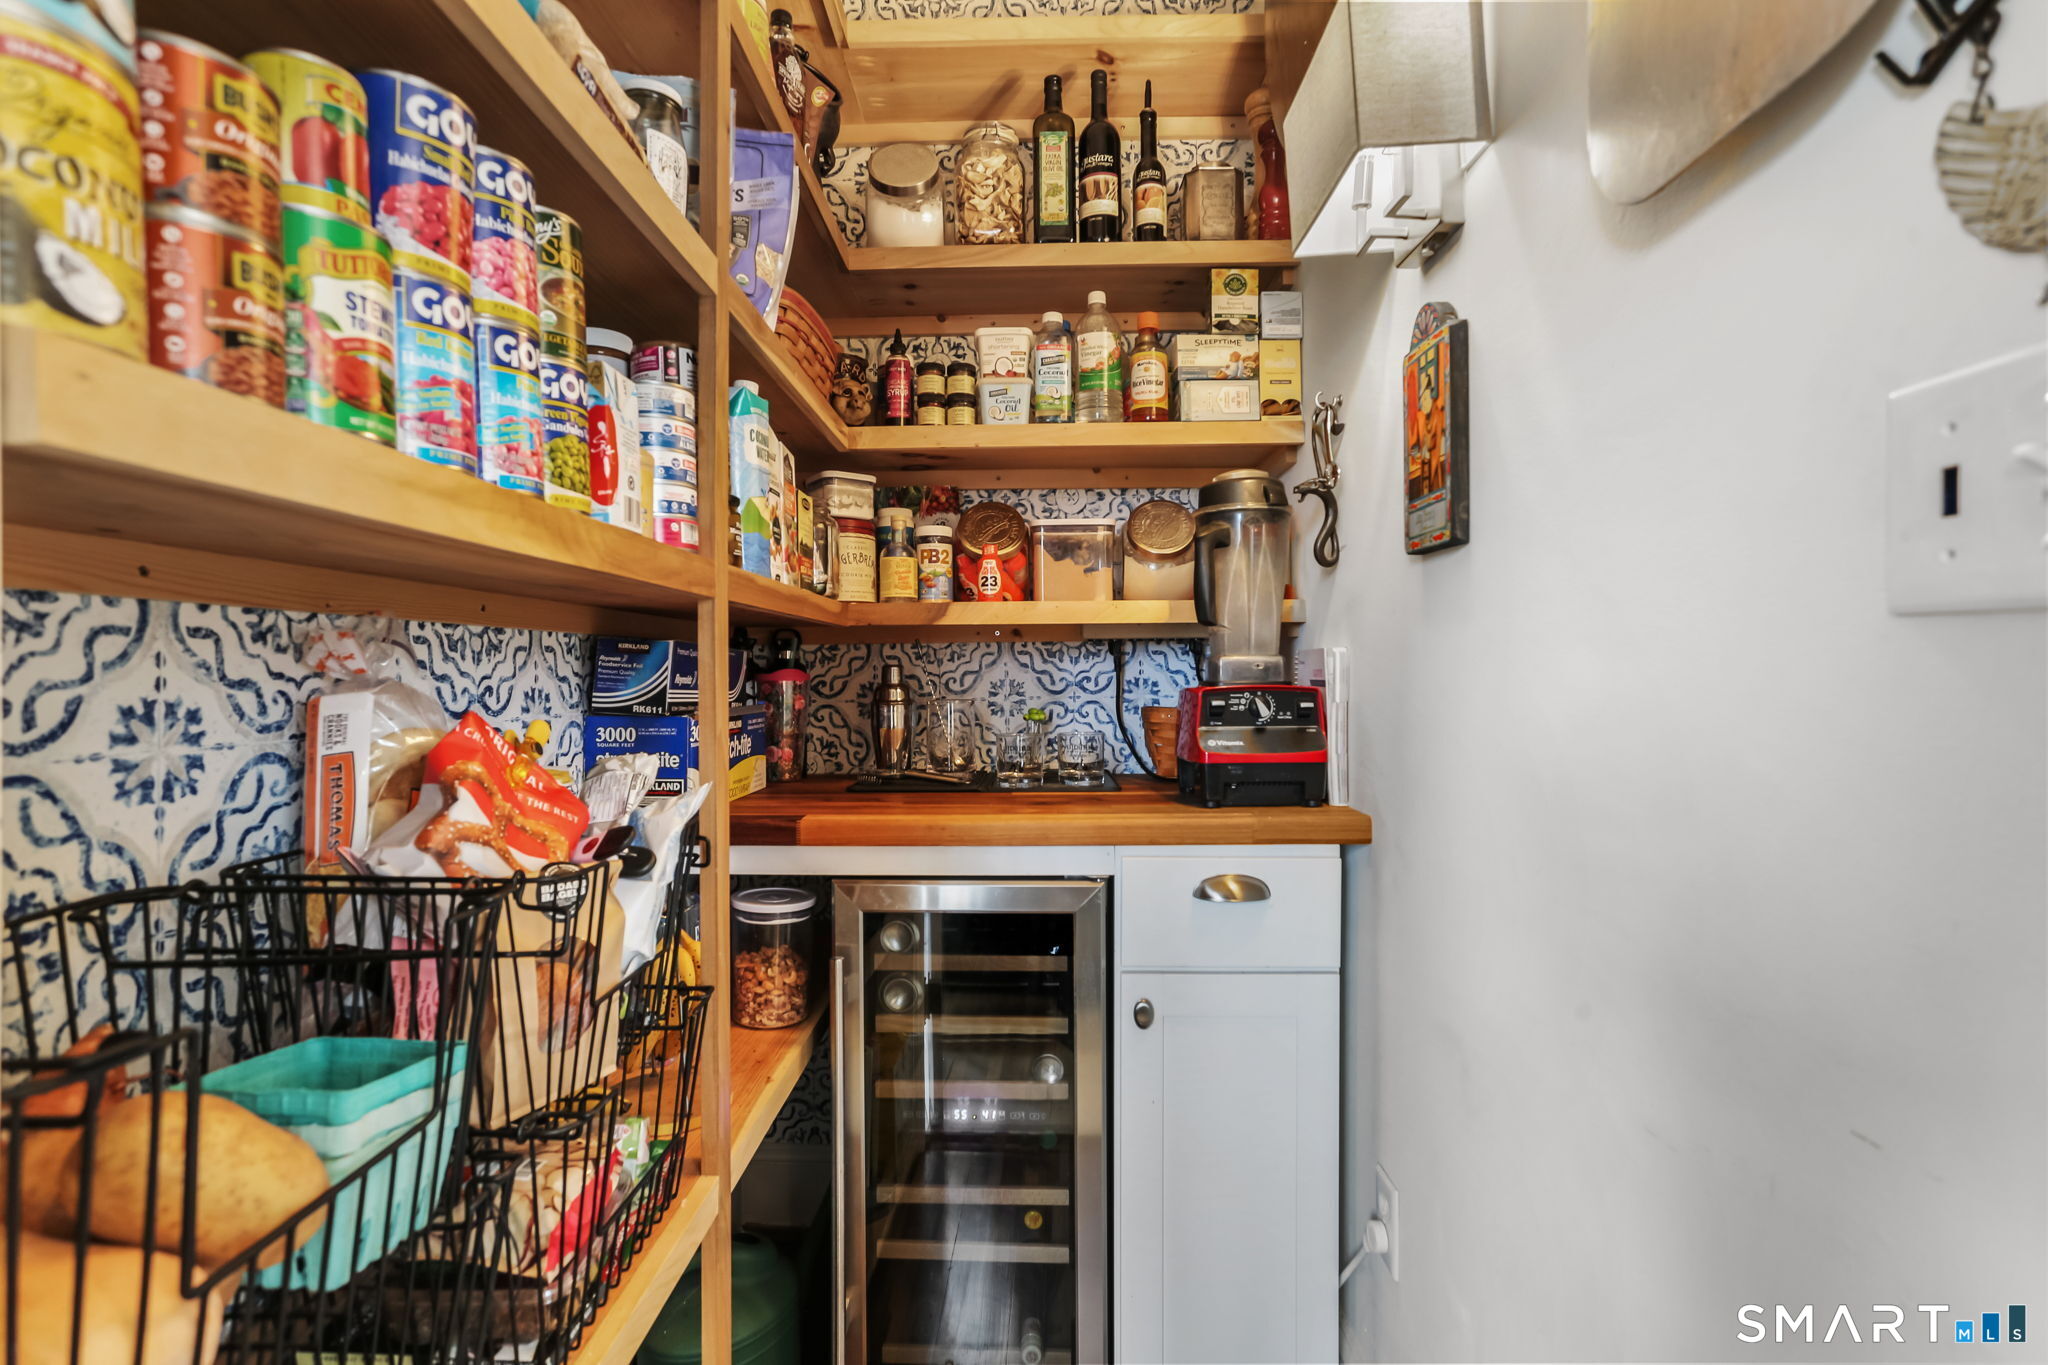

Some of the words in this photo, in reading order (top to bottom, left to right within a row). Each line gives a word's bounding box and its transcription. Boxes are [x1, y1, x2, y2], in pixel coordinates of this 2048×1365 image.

[541, 407, 569, 422] reen
[1004, 403, 1018, 413] Oil
[920, 548, 950, 565] PB2
[980, 575, 998, 587] 23
[618, 642, 650, 650] KIRKLAND
[632, 705, 663, 714] RK611
[595, 726, 637, 743] 3000
[326, 762, 345, 852] THOMAS
[526, 797, 551, 813] THE
[553, 804, 579, 825] REST
